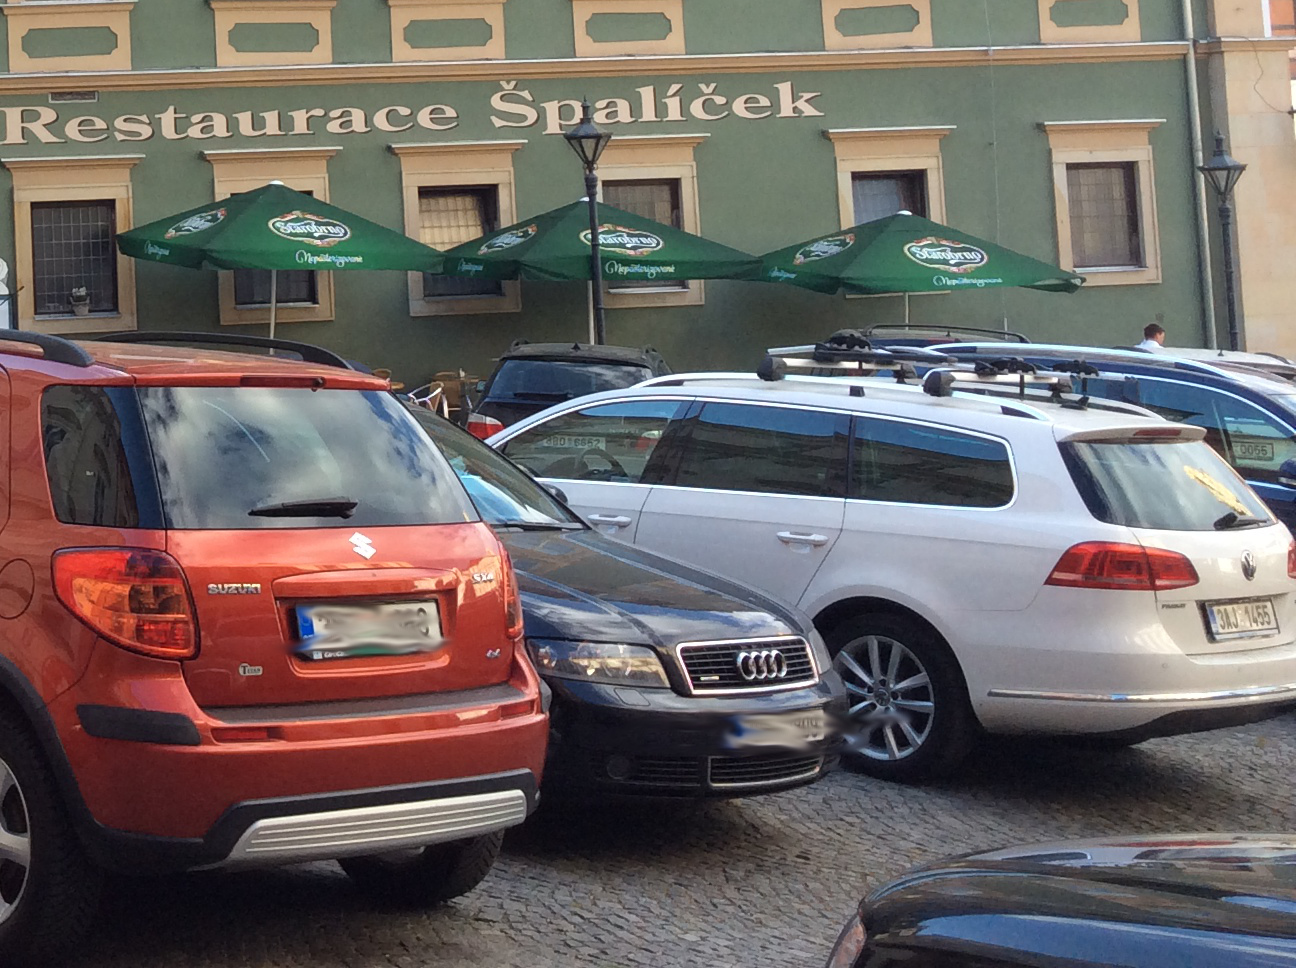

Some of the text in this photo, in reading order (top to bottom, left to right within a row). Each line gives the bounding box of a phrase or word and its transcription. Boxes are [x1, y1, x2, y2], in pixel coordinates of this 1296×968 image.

[490, 80, 825, 135] Špalíček
[276, 220, 345, 238] Starobrno
[586, 232, 658, 248] tarobrno
[910, 246, 982, 264] Starobrno
[472, 572, 495, 585] SX4
[207, 583, 261, 594] SUZUKI
[1216, 604, 1272, 631] 3AJ 1455
